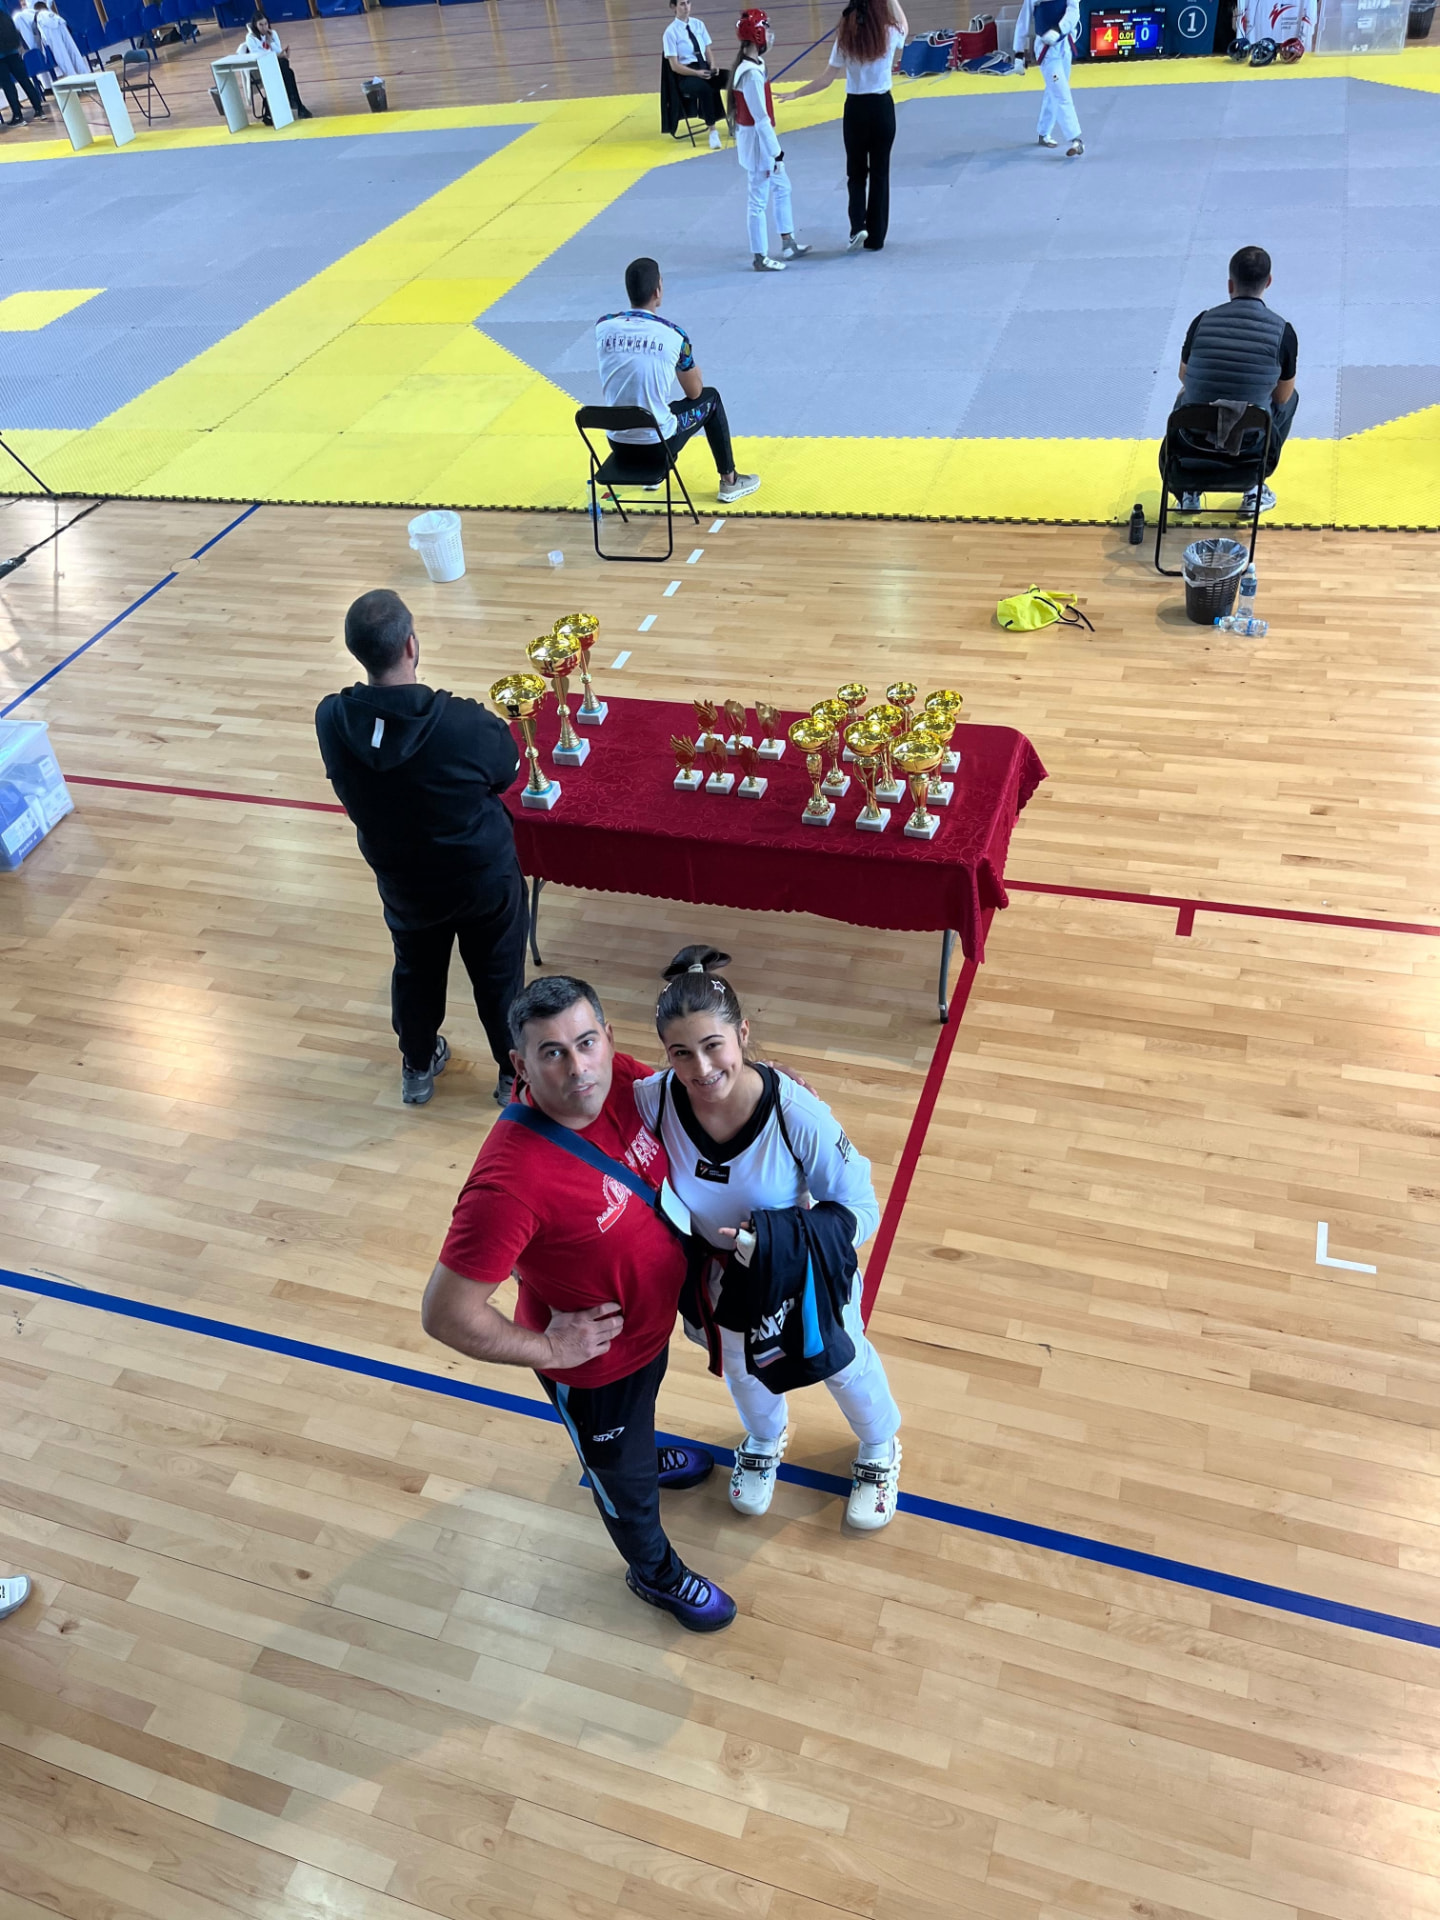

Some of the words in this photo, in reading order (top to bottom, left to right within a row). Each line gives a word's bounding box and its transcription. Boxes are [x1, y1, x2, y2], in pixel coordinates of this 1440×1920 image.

[1187, 12, 1197, 32] 1
[1103, 28, 1113, 42] 4
[1119, 31, 1134, 40] 0.01
[1141, 27, 1149, 41] 0
